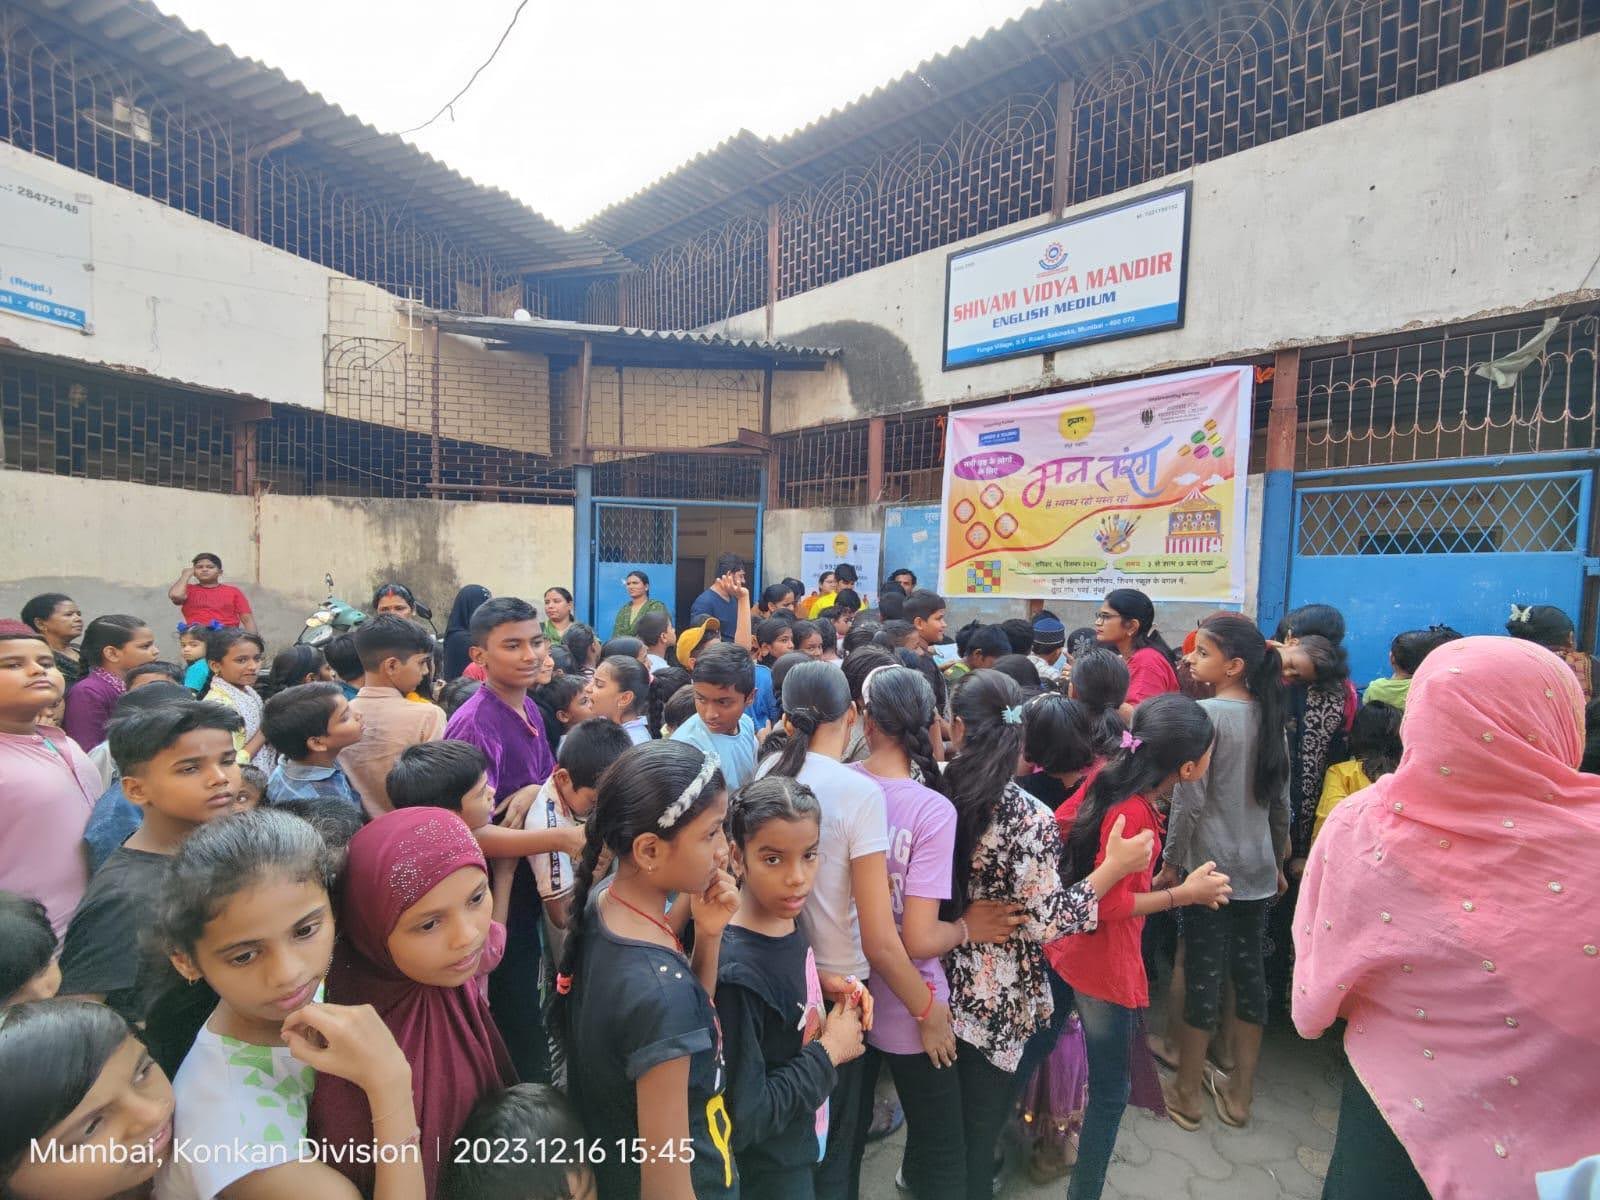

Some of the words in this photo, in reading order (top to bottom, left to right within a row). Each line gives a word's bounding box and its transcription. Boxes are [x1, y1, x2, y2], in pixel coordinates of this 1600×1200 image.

[26, 301, 50, 313] 400
[953, 290, 1016, 322] SHIVAM
[1023, 276, 1078, 305] VIDYA
[1086, 251, 1173, 291] MANDIR
[992, 305, 1049, 328] ENGLISH
[1054, 291, 1117, 314] MEDIUM
[1022, 456, 1095, 508] मन
